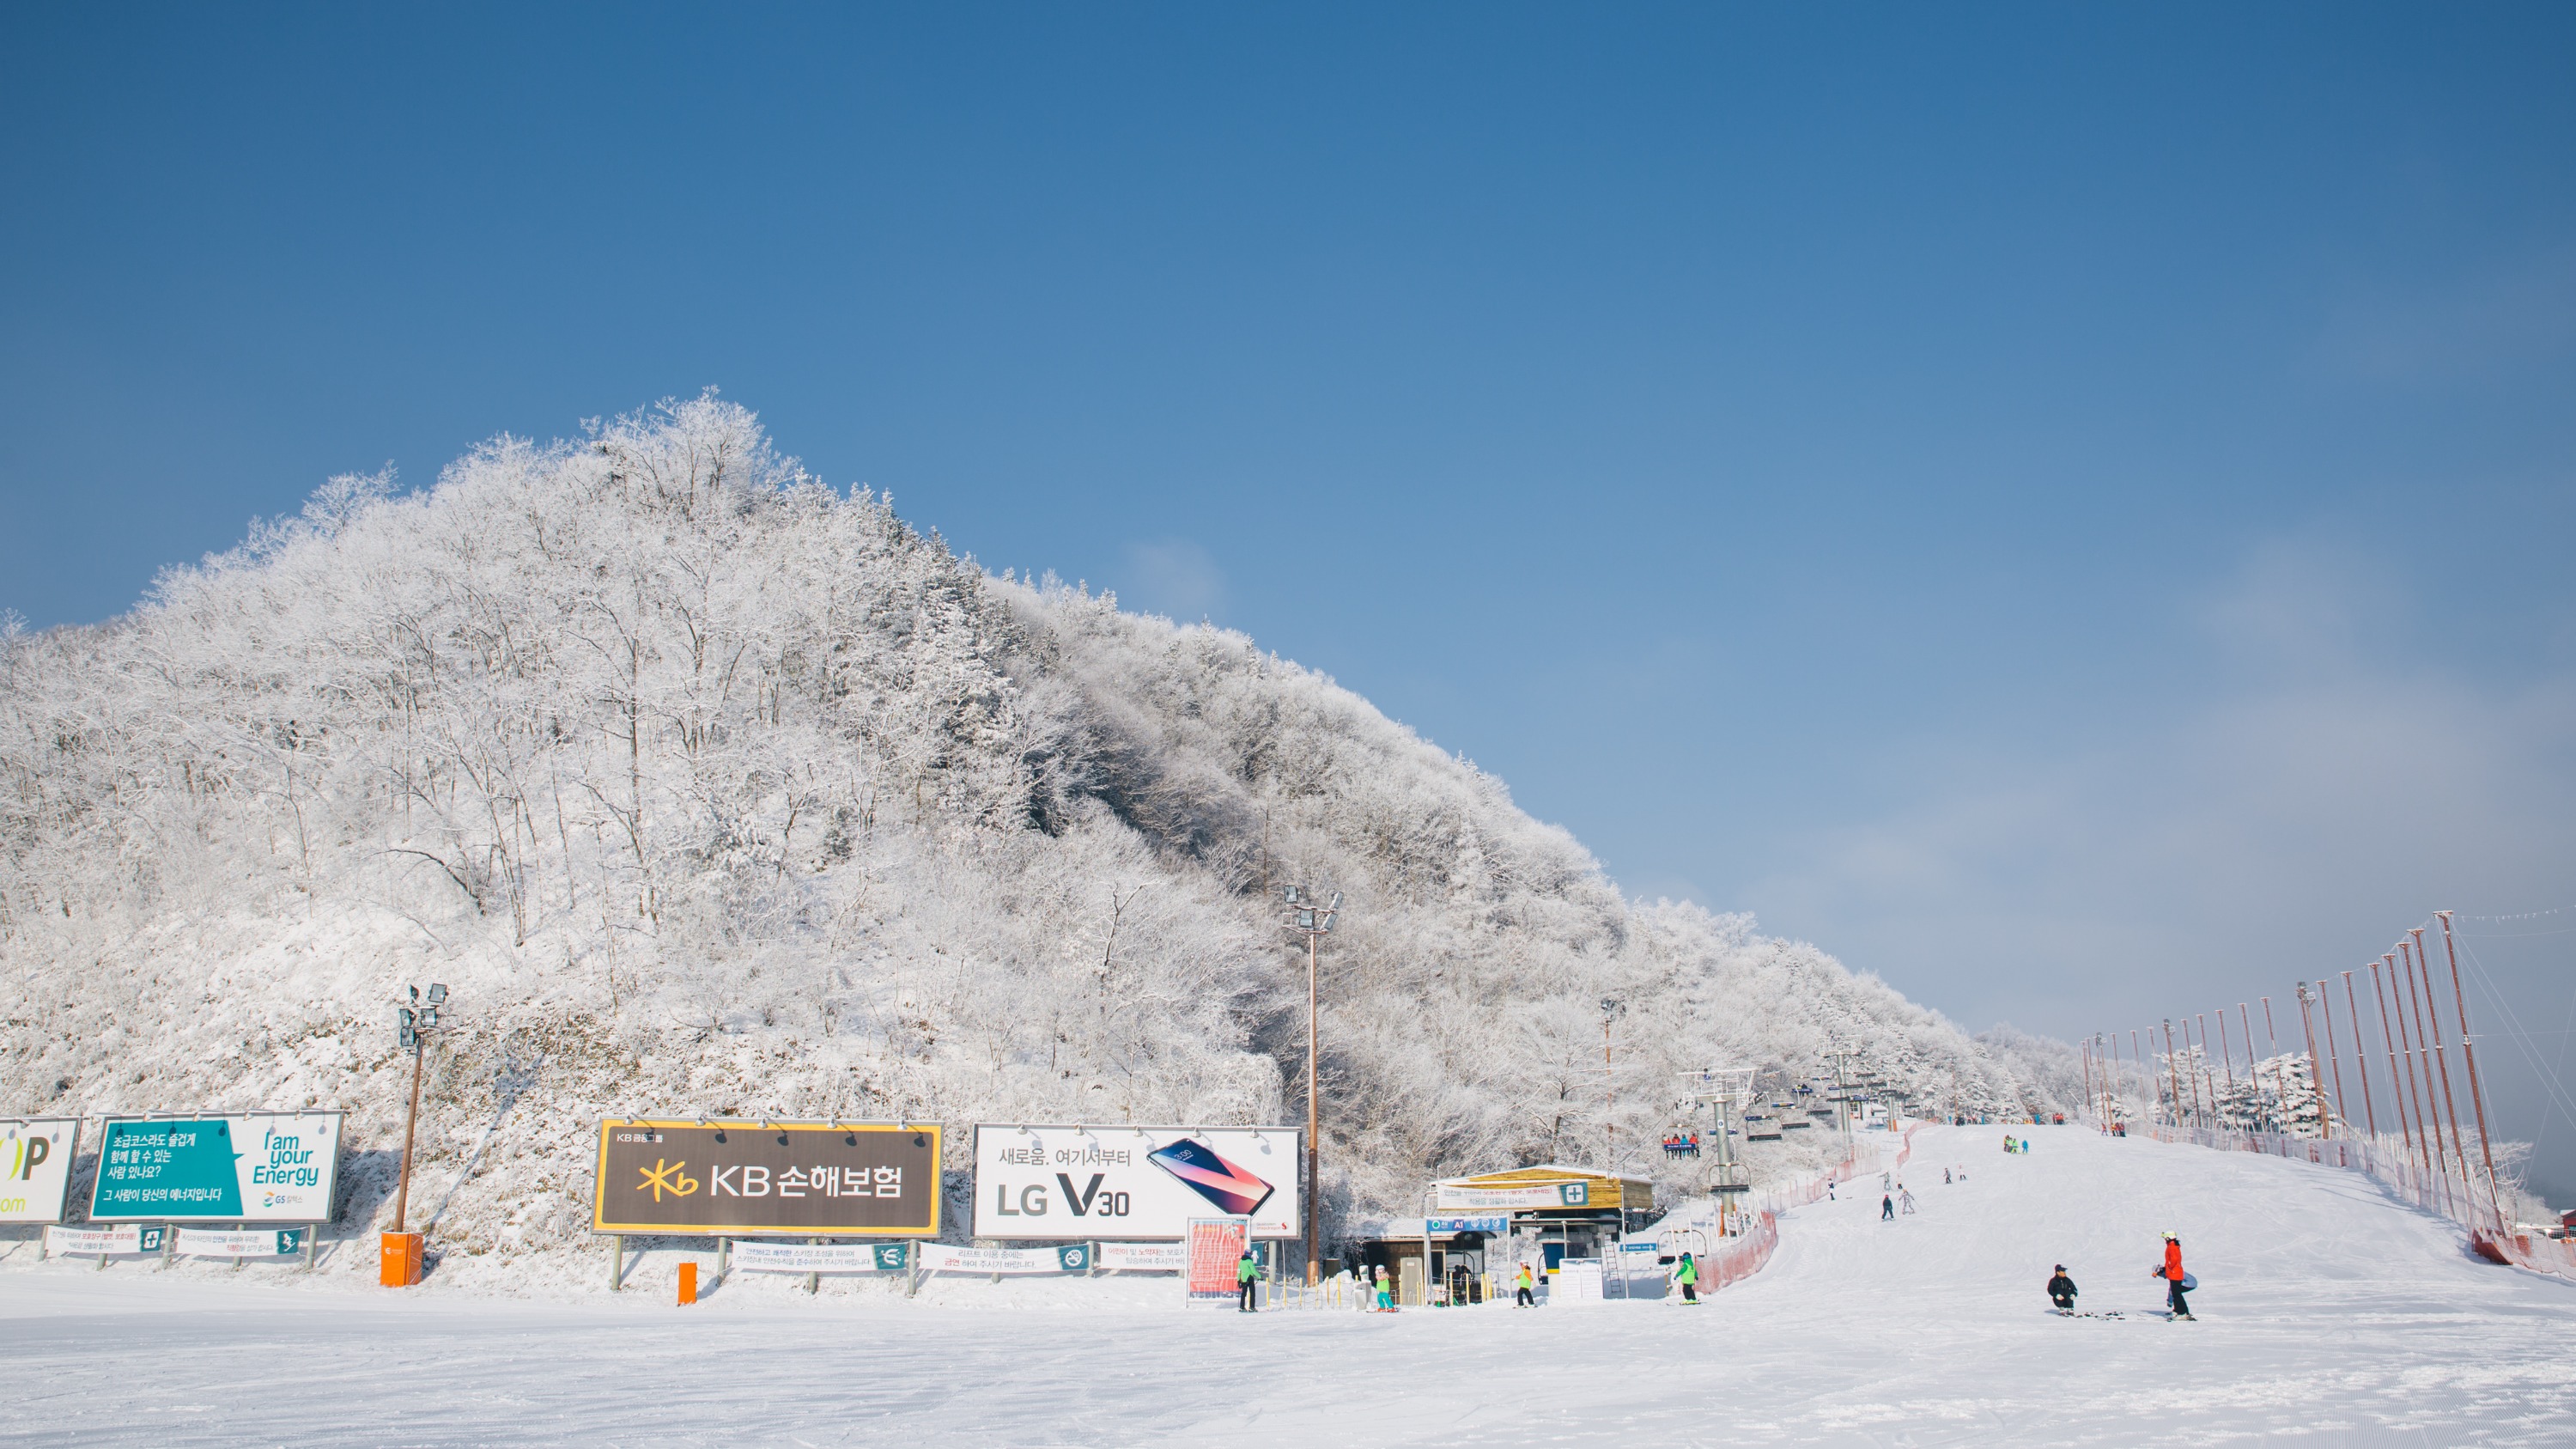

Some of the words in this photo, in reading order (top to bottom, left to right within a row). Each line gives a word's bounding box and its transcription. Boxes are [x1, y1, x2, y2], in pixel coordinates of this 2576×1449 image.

[112, 1134, 167, 1148] 초급코스라도
[168, 1133, 197, 1147] 즐겁게
[264, 1131, 270, 1150] I
[272, 1136, 299, 1150] am
[617, 1134, 632, 1142] KB
[111, 1150, 129, 1164] 함께
[131, 1150, 140, 1164] 할
[142, 1151, 151, 1163] 수
[154, 1149, 172, 1163] 있는
[270, 1150, 313, 1169] your
[999, 1148, 1049, 1166] 새로움.
[1055, 1148, 1131, 1166] 여기서부터
[107, 1166, 126, 1179] 사람
[128, 1166, 161, 1179] 있나요?
[252, 1166, 319, 1186] Energy
[710, 1165, 771, 1196] KB
[777, 1165, 902, 1198] 손해보험
[103, 1190, 112, 1201] 그
[114, 1188, 139, 1202] 사람이
[142, 1188, 168, 1202] 당신의
[169, 1188, 222, 1202] 에너지입니다
[275, 1195, 286, 1203] GS
[997, 1184, 1048, 1216] LG
[1055, 1173, 1130, 1216] V30
[0, 1198, 26, 1213] om
[1454, 1221, 1464, 1229] A1
[793, 1249, 813, 1257] 스키장
[814, 1249, 834, 1257] 조성을
[835, 1249, 855, 1257] 위하여
[958, 1249, 981, 1258] 리프트
[983, 1250, 999, 1258] 이용
[1001, 1250, 1024, 1259] 중에는
[736, 1256, 762, 1264] 스키장내
[796, 1257, 823, 1266] 준수하여
[844, 1257, 871, 1266] 바랍니다.
[945, 1258, 960, 1267] 금연
[962, 1259, 978, 1268] 하여
[979, 1260, 1003, 1269] 주시기
[1004, 1260, 1036, 1269] 바랍니다.
